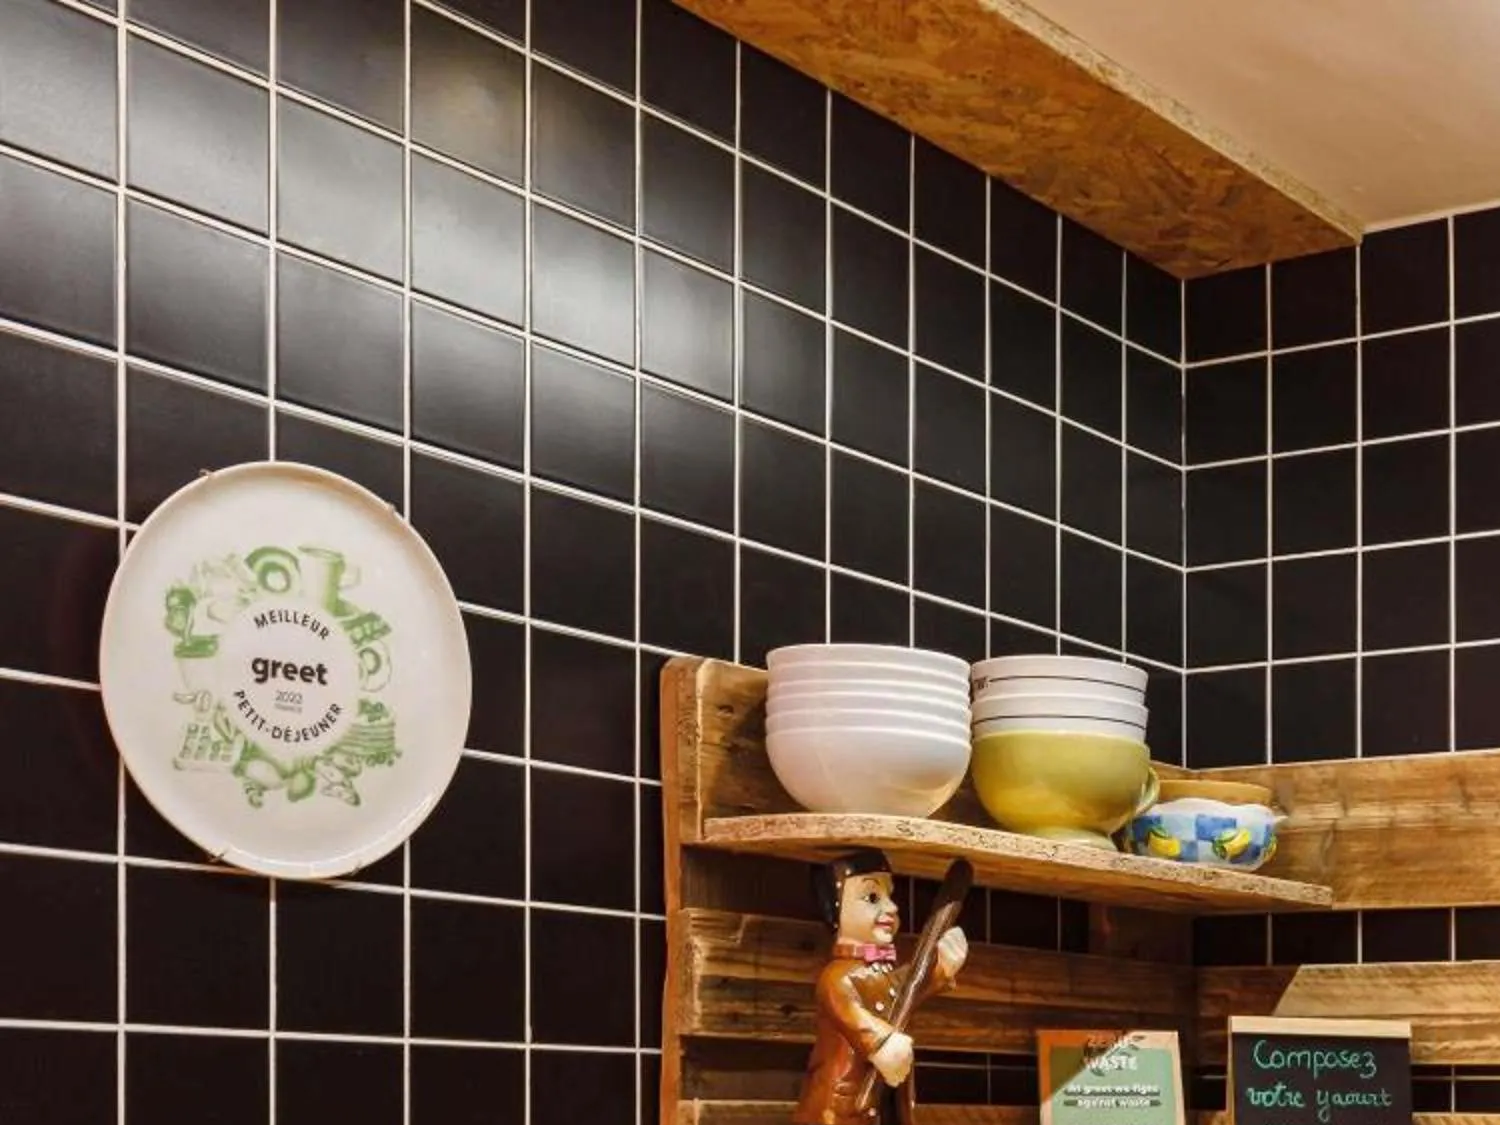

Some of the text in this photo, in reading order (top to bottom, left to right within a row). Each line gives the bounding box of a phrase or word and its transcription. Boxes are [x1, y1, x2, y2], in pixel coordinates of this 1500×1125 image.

[253, 609, 329, 640] MEILLEUR
[252, 657, 328, 686] greet
[234, 689, 342, 743] PETIT-DÉJEUNER
[1253, 1039, 1376, 1079] Composez
[1246, 1081, 1392, 1122] votre yaourt
